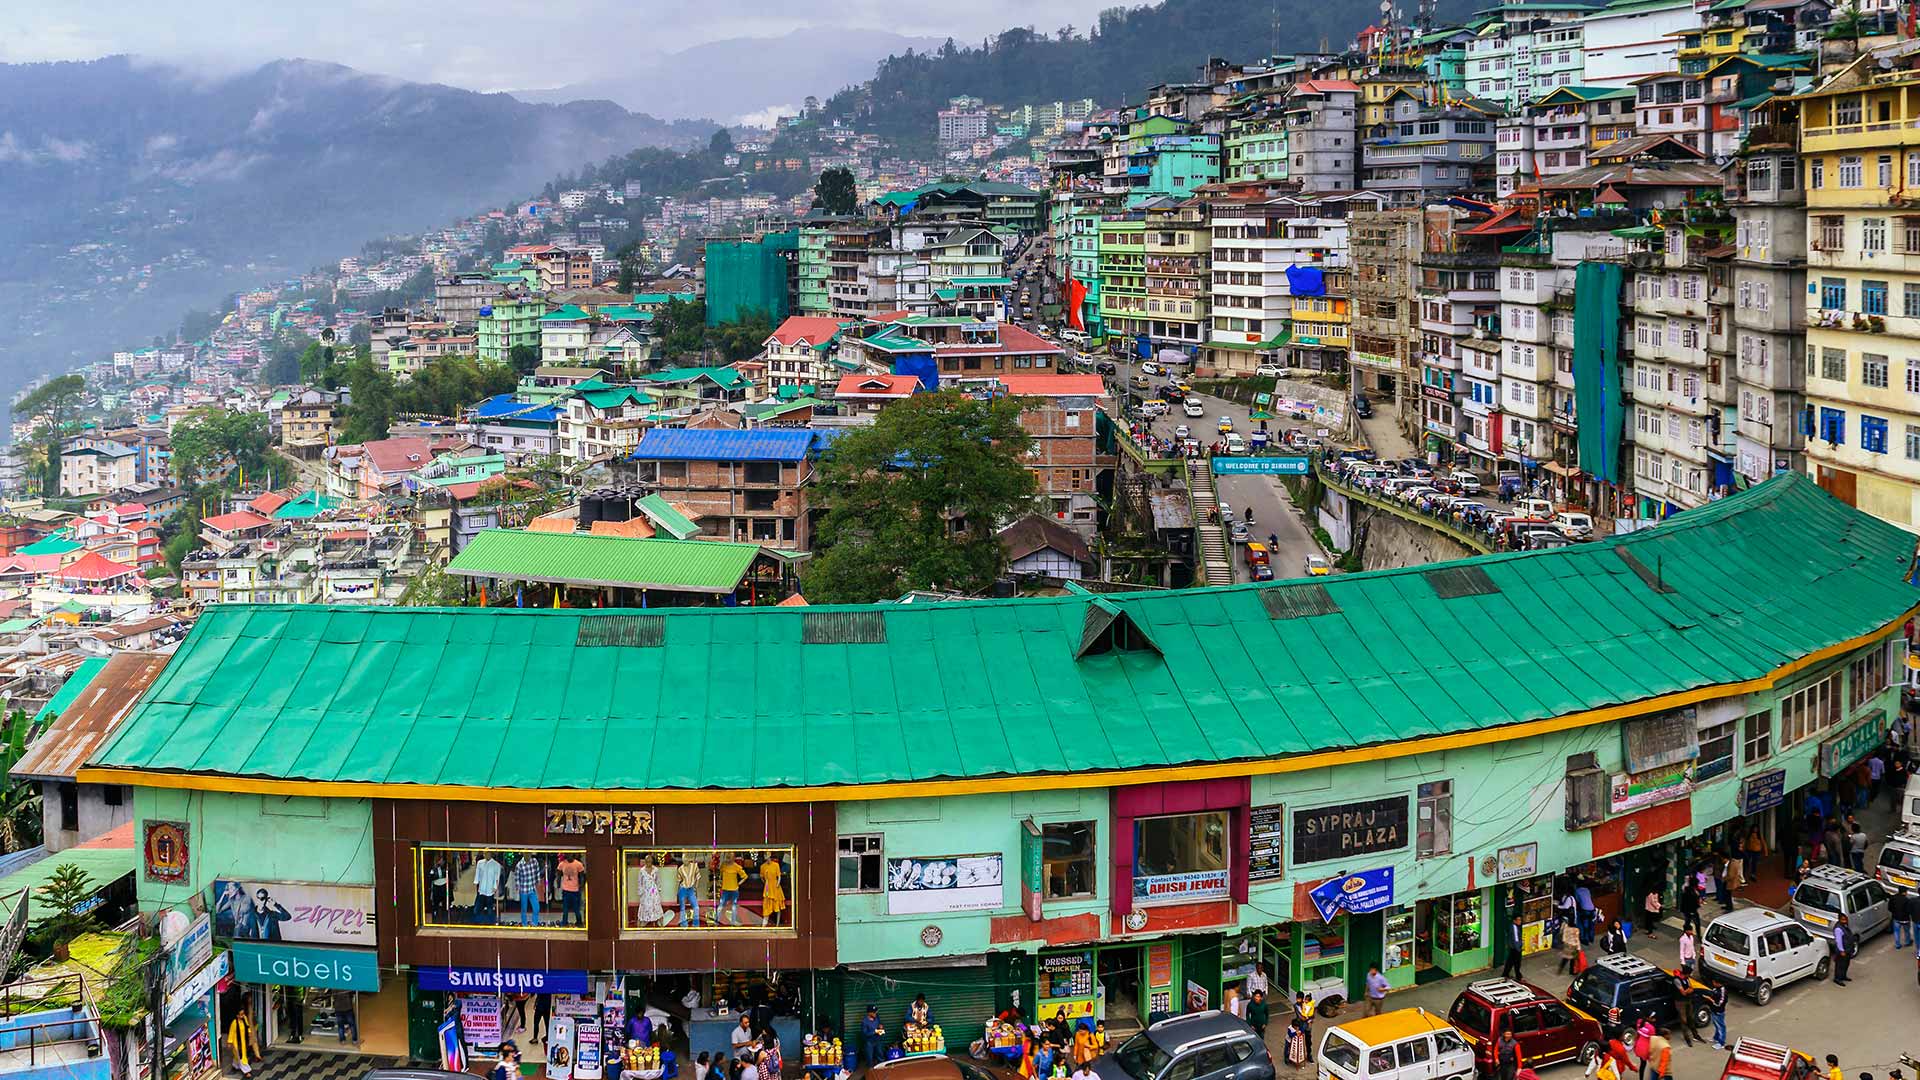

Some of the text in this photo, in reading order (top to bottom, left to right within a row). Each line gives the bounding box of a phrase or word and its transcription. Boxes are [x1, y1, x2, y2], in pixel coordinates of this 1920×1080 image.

[1841, 720, 1877, 756] POTALA
[546, 809, 653, 834] ZIPPER
[1306, 809, 1375, 834] SYPRAJ
[1341, 824, 1397, 849] PLAZA
[1502, 867, 1532, 878] COLLECTION
[258, 953, 353, 982] Labels
[1045, 956, 1083, 965] DRESSED
[1046, 965, 1081, 973] CHICKEN
[450, 971, 544, 987] SAMSUNG
